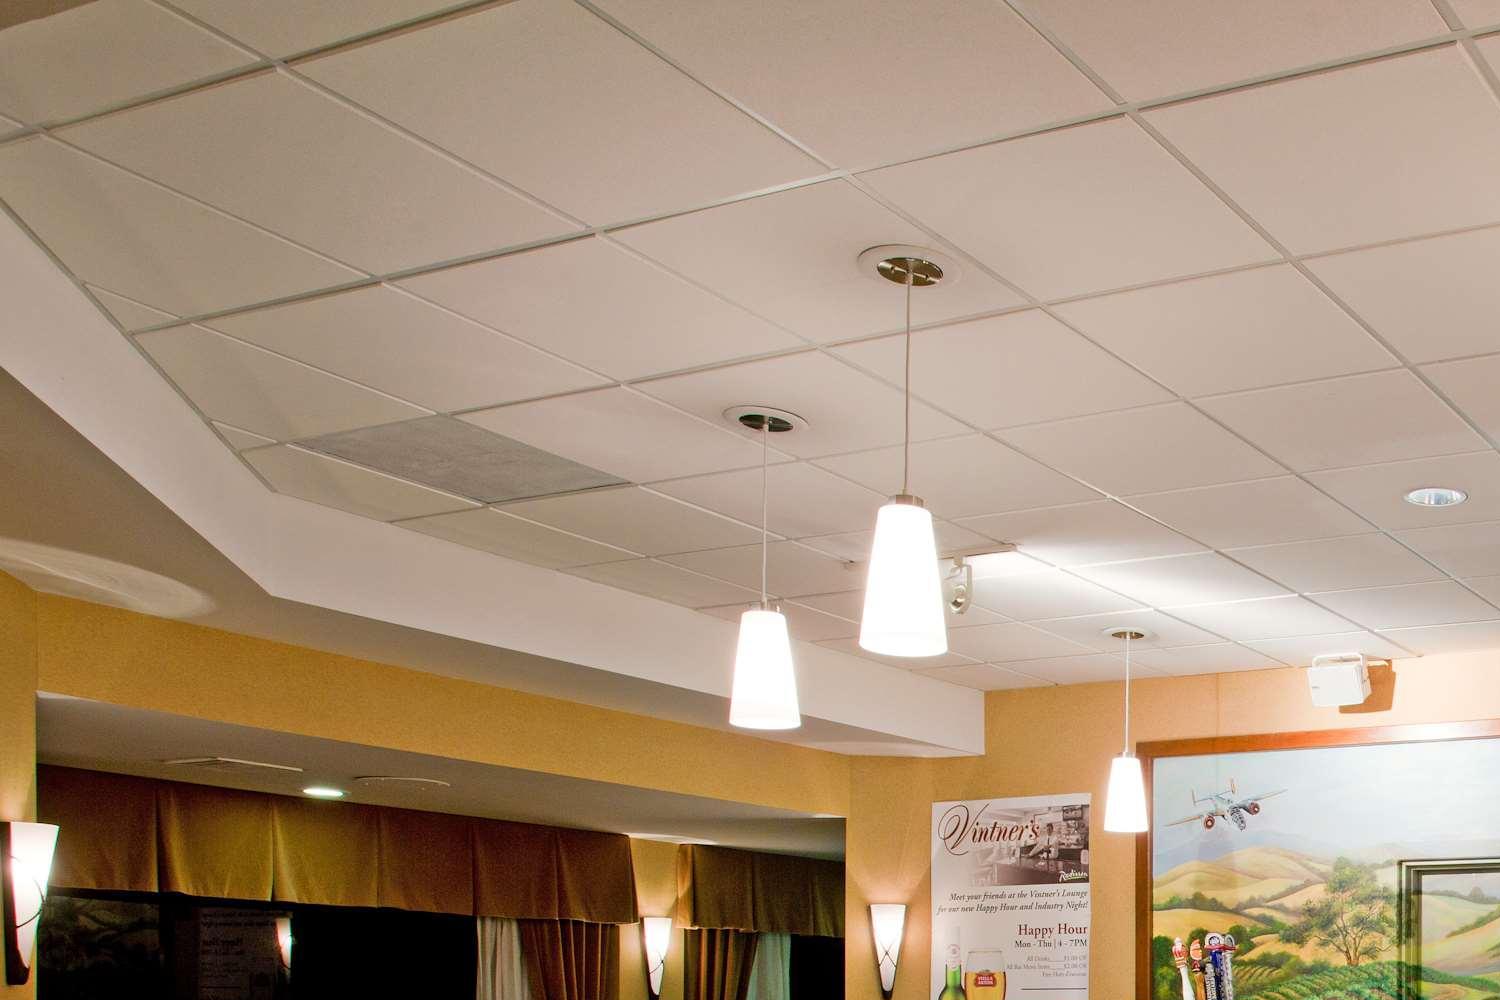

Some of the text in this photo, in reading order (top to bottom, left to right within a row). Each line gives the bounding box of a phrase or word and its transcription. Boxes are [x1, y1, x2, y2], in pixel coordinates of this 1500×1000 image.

[938, 803, 1040, 856] Vintner's
[950, 893, 965, 901] Meet
[966, 894, 982, 902] your
[982, 891, 1007, 902] friends
[1029, 889, 1061, 898] Vintner's
[1061, 889, 1088, 898] Lounge
[976, 904, 998, 914] Happy
[1000, 903, 1018, 911] Hour
[1034, 902, 1065, 912] Industry
[1066, 901, 1088, 911] Night!
[1018, 923, 1088, 938] Happy Hour
[1015, 940, 1031, 948] Mon
[1038, 940, 1052, 948] Thu
[1070, 939, 1088, 947] 7PM
